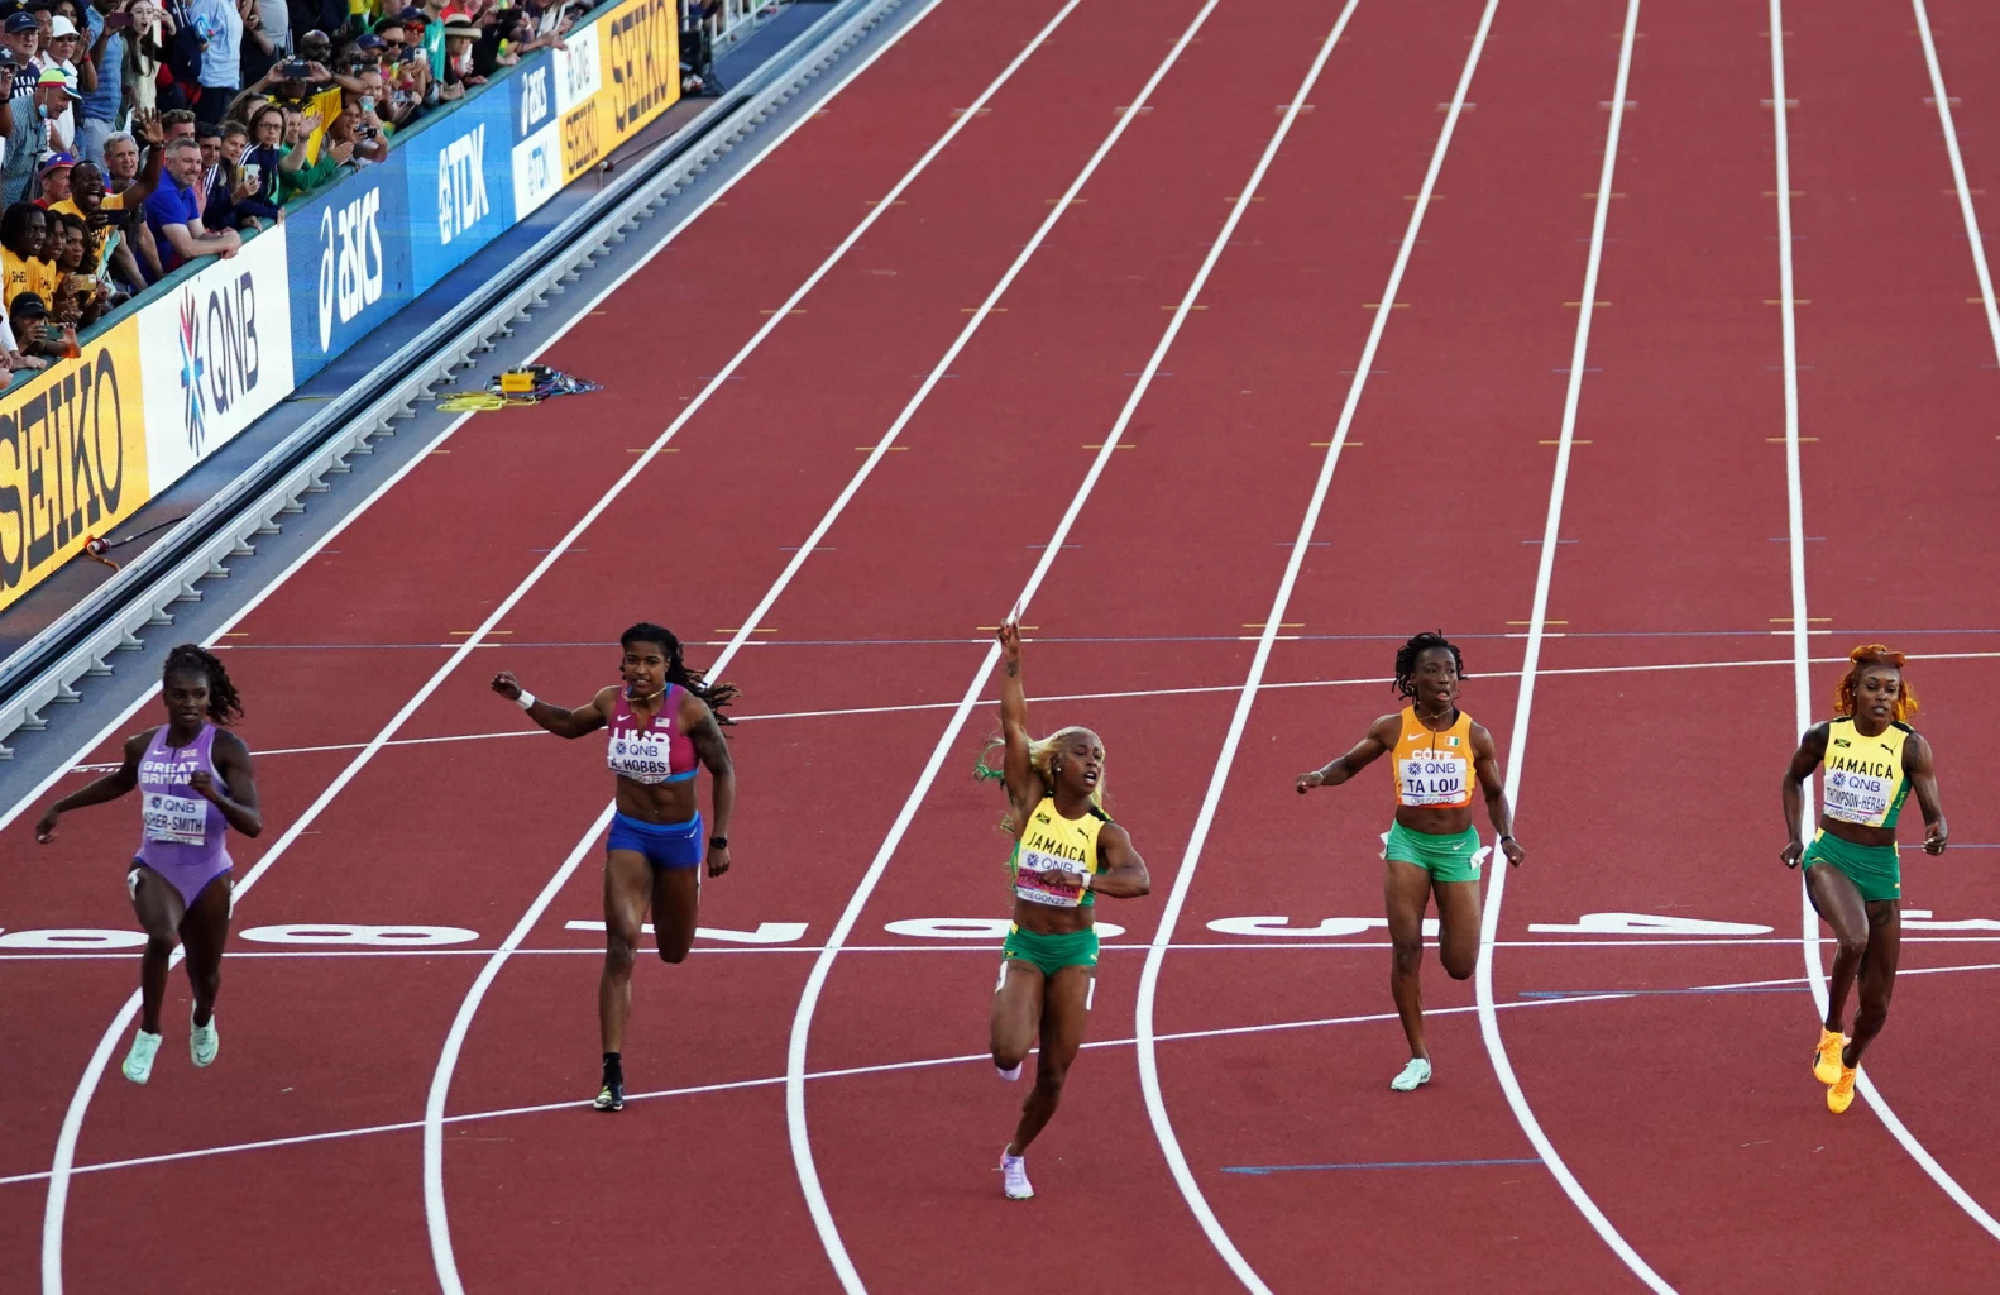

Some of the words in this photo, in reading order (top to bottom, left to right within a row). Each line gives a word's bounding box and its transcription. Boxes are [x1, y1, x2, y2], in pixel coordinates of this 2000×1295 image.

[611, 0, 669, 133] SEIKO
[565, 99, 599, 175] SEIKO
[449, 123, 489, 235] TDK
[338, 186, 383, 325] asics
[208, 270, 259, 416] QNB
[0, 347, 123, 589] SEIKO
[629, 744, 658, 757] QNB
[143, 760, 198, 774] GREAT
[624, 759, 666, 774] HOBBS
[1425, 763, 1456, 774] QNB
[1830, 755, 1894, 780] JAMAICA
[1407, 779, 1426, 793] TA
[1430, 778, 1459, 793] LOU
[1849, 776, 1881, 793] QNB
[163, 803, 196, 814] QNB
[1027, 832, 1086, 863] JAMAICA
[238, 924, 480, 945] 8
